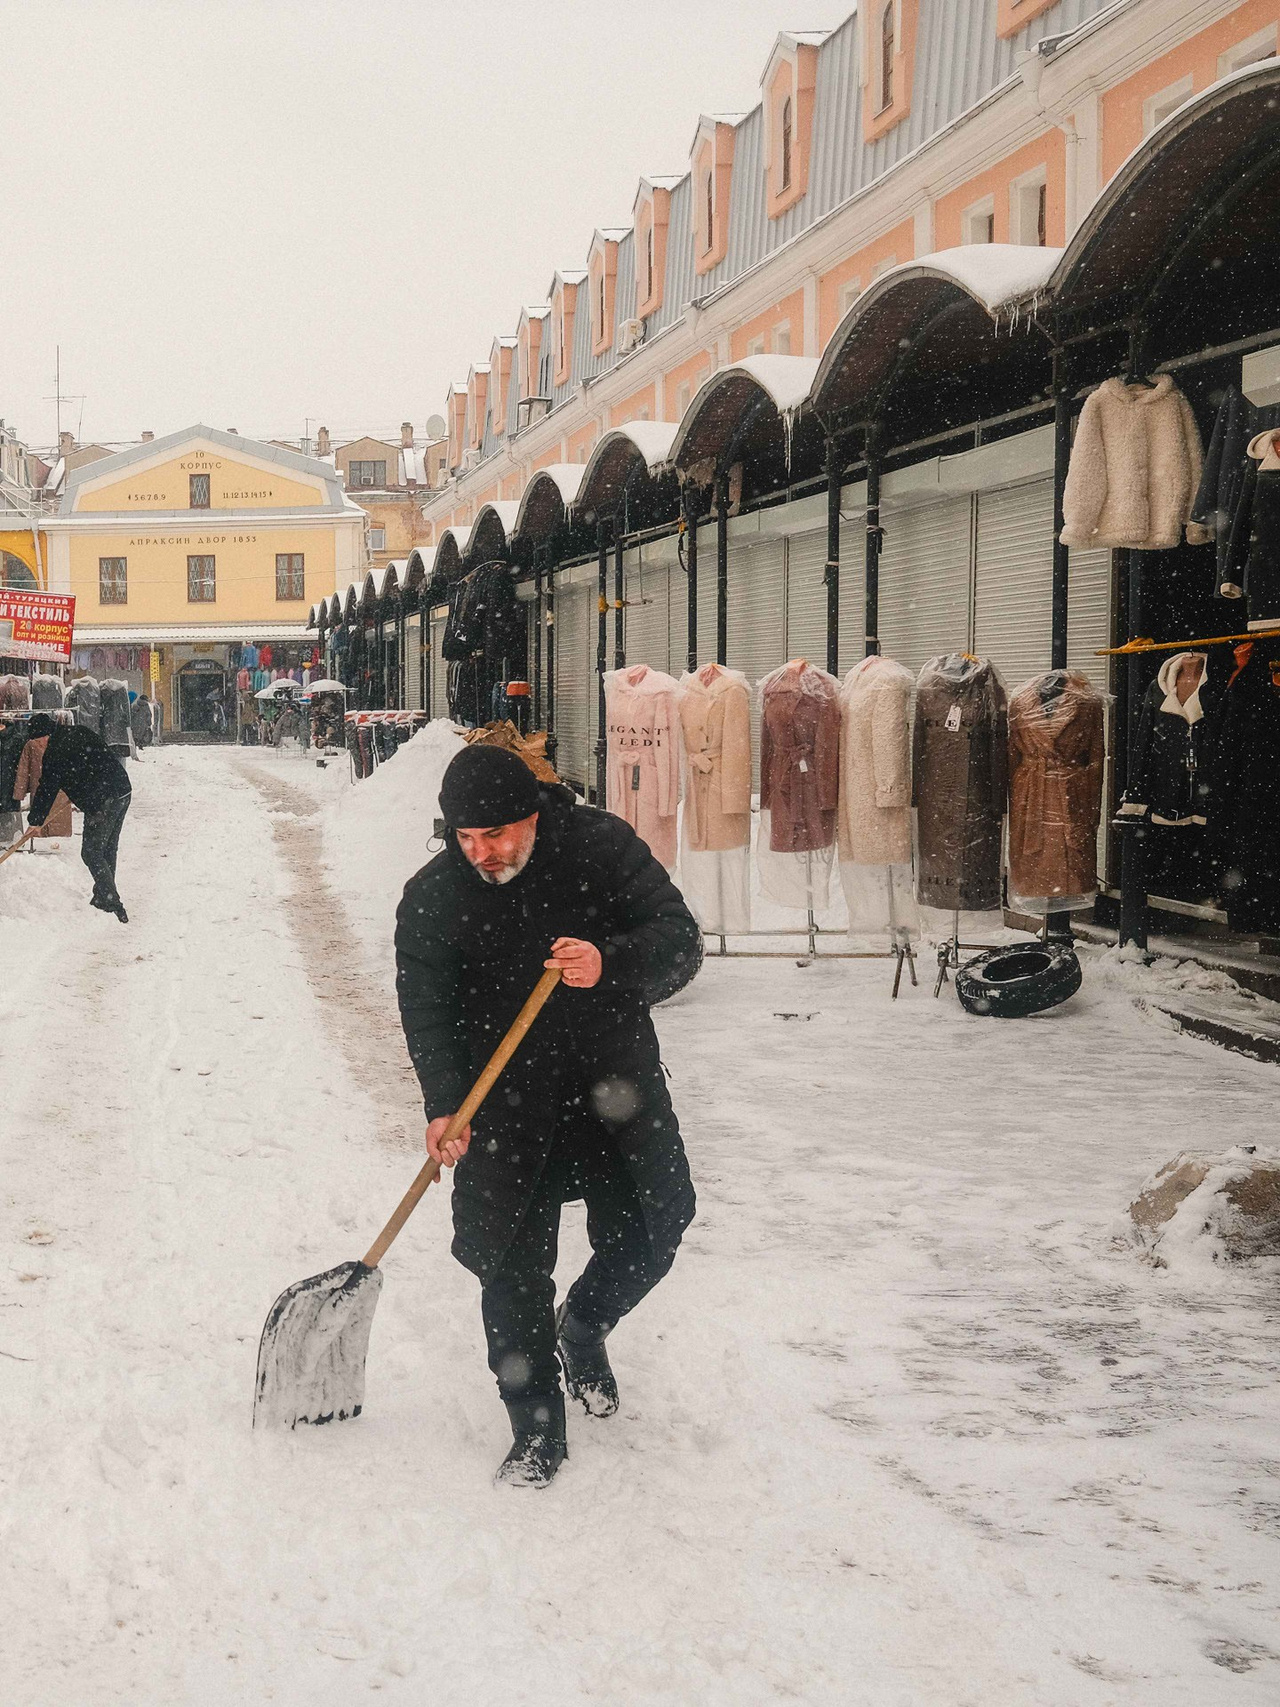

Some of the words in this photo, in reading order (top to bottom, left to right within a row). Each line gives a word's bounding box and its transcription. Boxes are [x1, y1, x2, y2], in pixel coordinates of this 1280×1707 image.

[195, 451, 205, 459] 10
[180, 461, 222, 470] КОРПУС
[129, 537, 191, 546] АПРАКСИН
[197, 536, 227, 544] ДВОР
[233, 535, 257, 543] 1853
[10, 604, 71, 622] ТЕКСТИЛЬ
[33, 623, 69, 635] корпус
[37, 633, 71, 643] розница
[619, 737, 662, 747] LEDI
